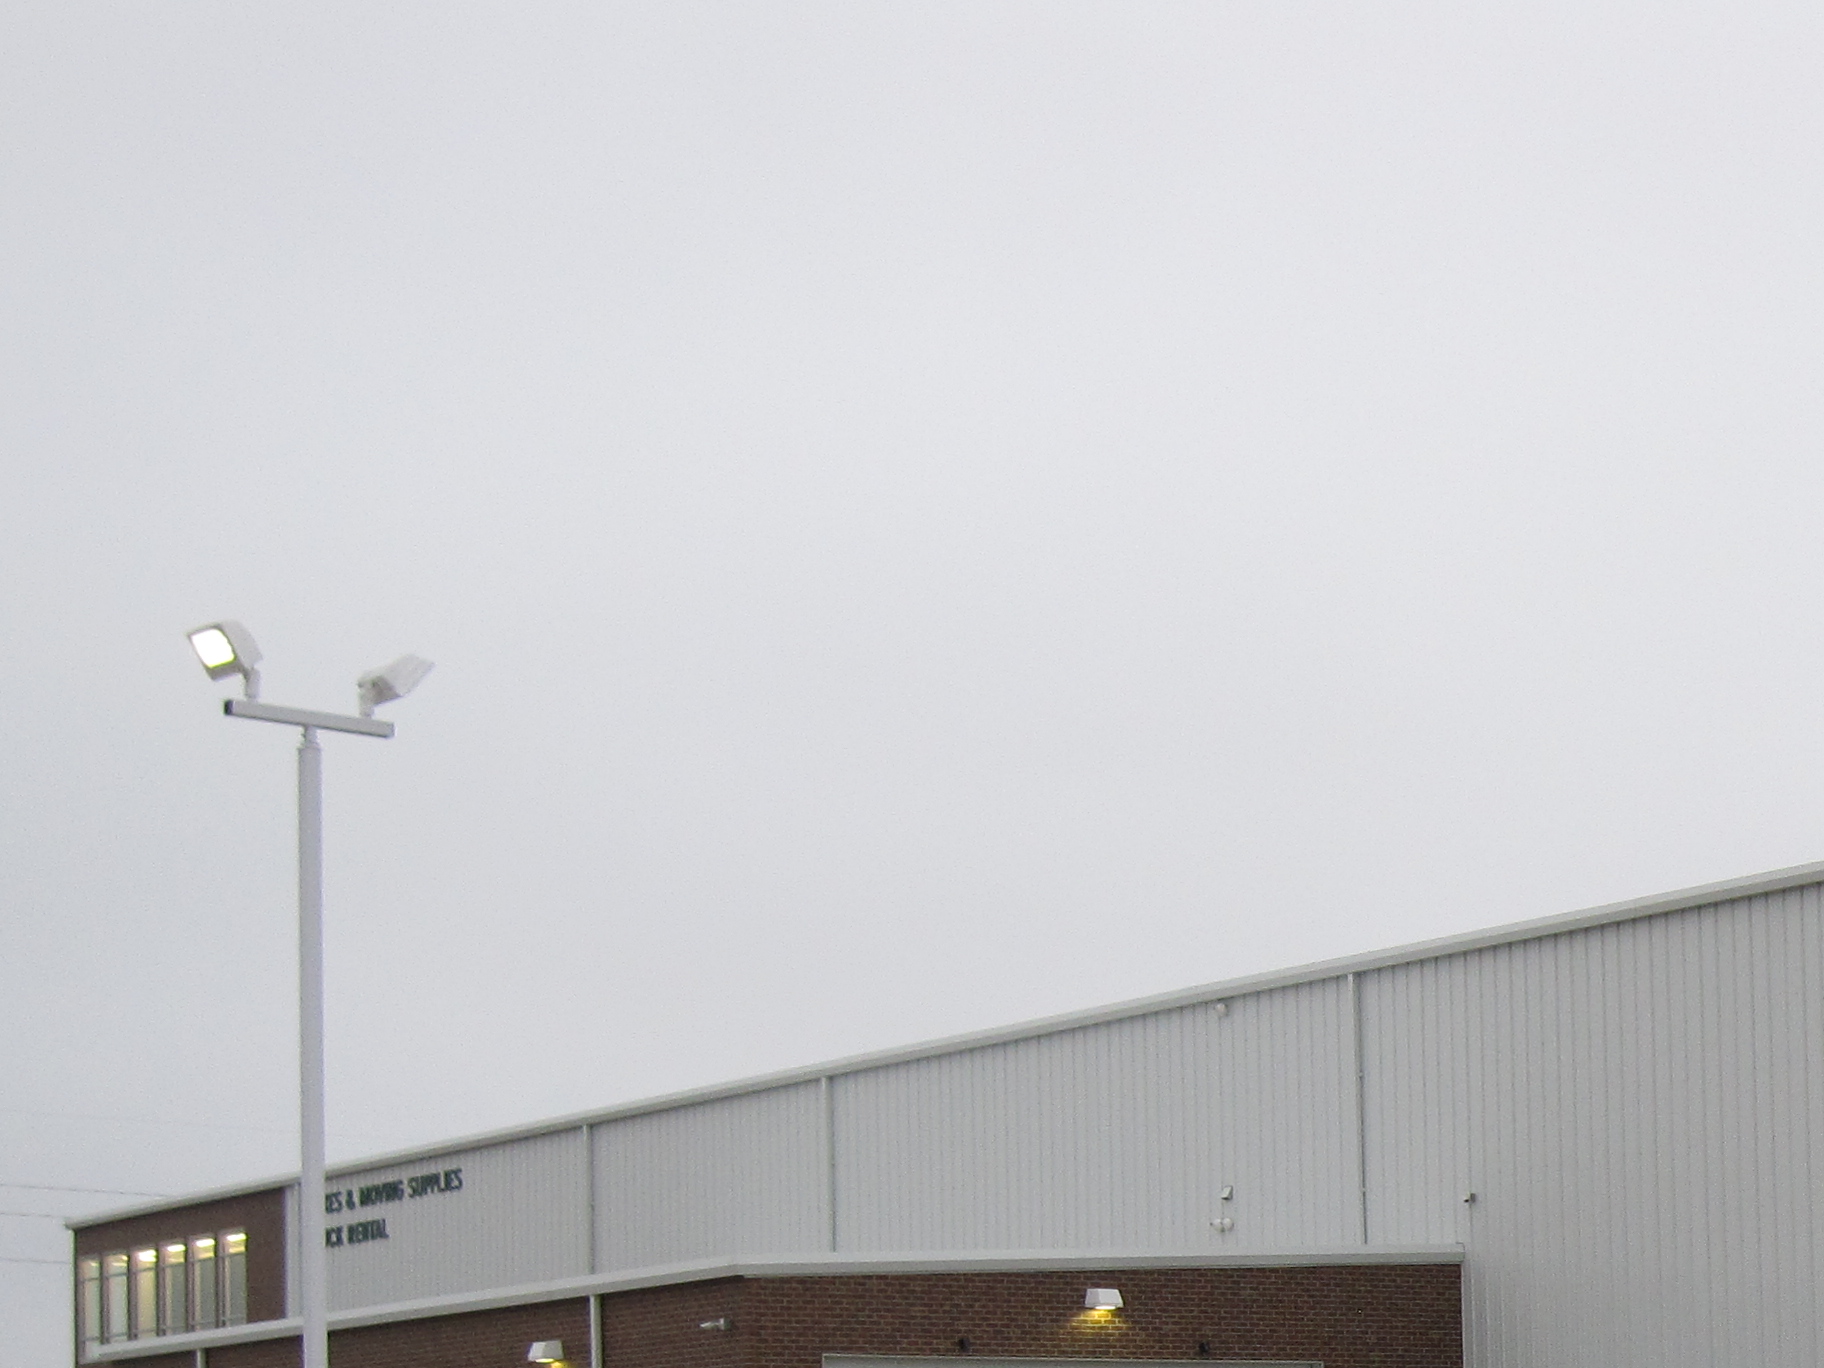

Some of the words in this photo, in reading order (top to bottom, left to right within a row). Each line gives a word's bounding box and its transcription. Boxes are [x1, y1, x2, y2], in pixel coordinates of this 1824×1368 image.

[345, 1189, 356, 1210] &
[359, 1179, 404, 1207] MOVING
[407, 1168, 463, 1199] SUPPLIES
[347, 1218, 389, 1245] RENTAL
